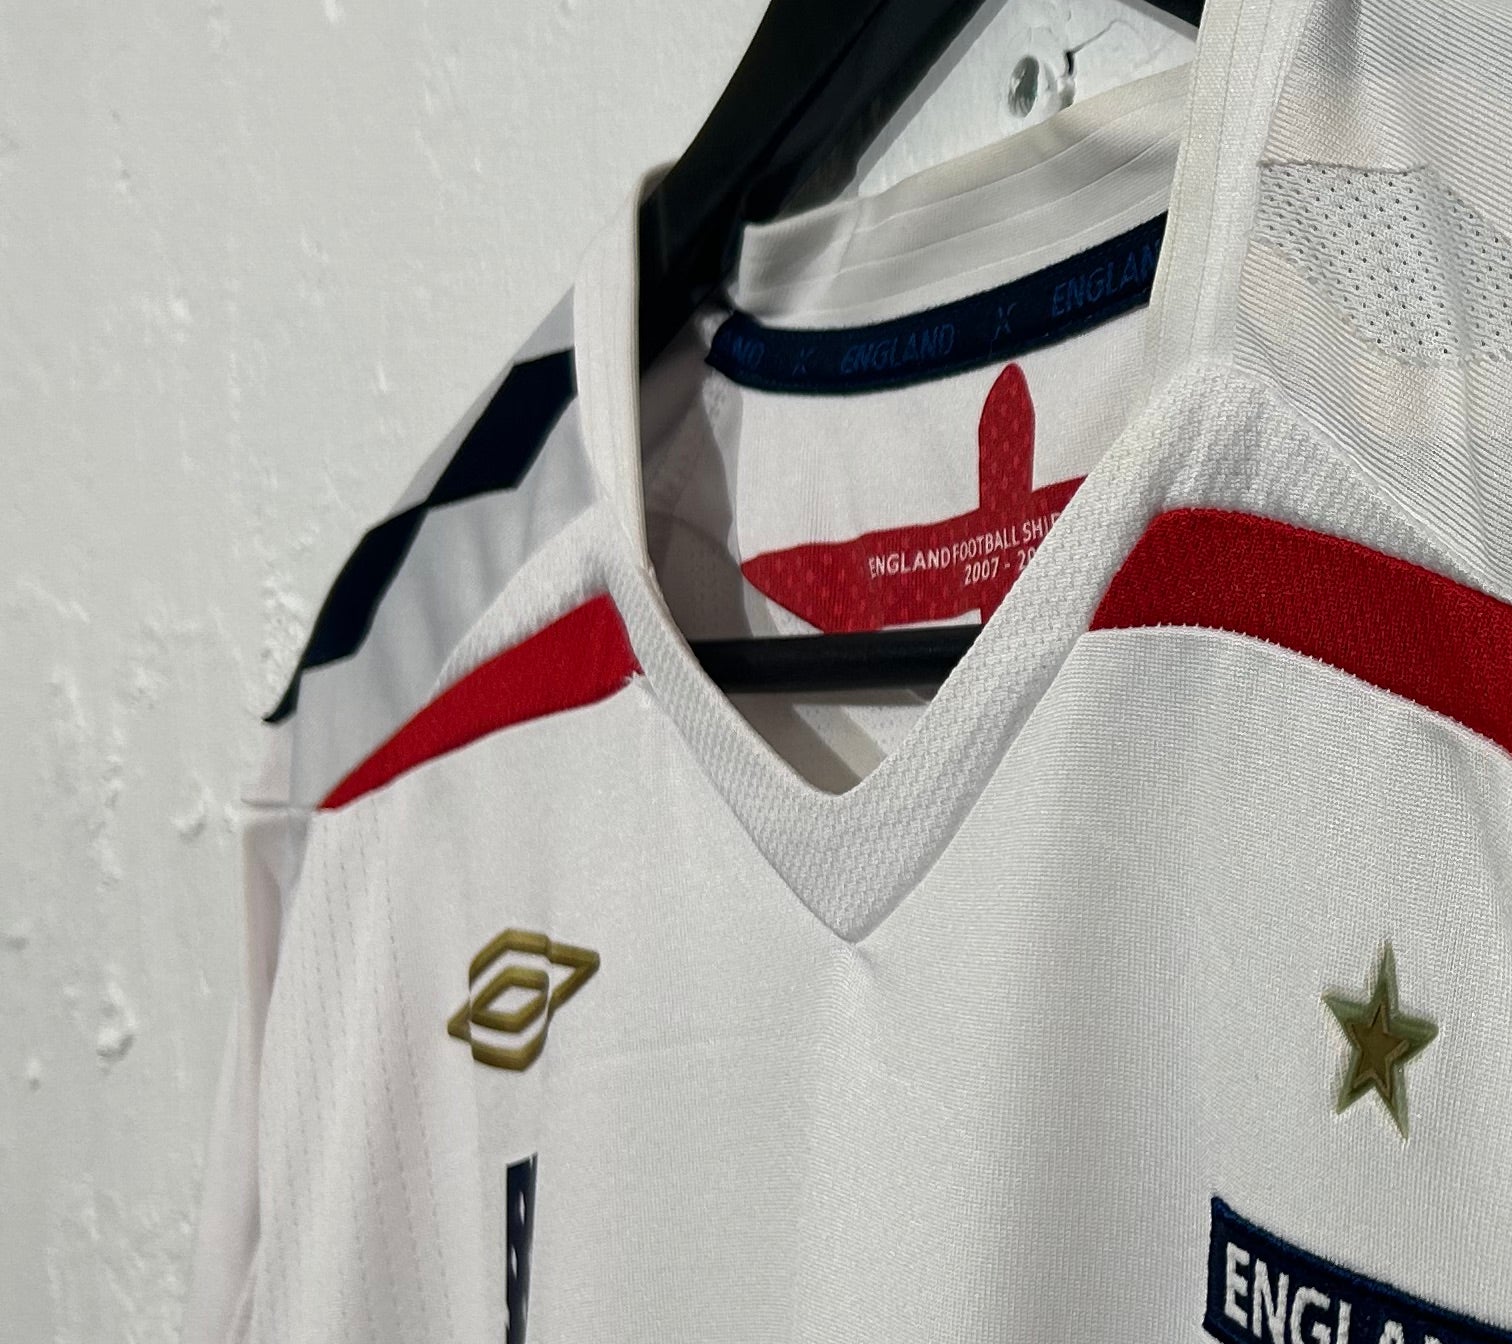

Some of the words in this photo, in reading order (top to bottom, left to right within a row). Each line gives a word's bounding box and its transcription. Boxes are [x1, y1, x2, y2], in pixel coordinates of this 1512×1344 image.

[840, 323, 956, 375] ENGLAND
[868, 546, 950, 579] ENGLAND
[952, 527, 1021, 565] FOOTBALL
[964, 557, 1000, 586] 2007
